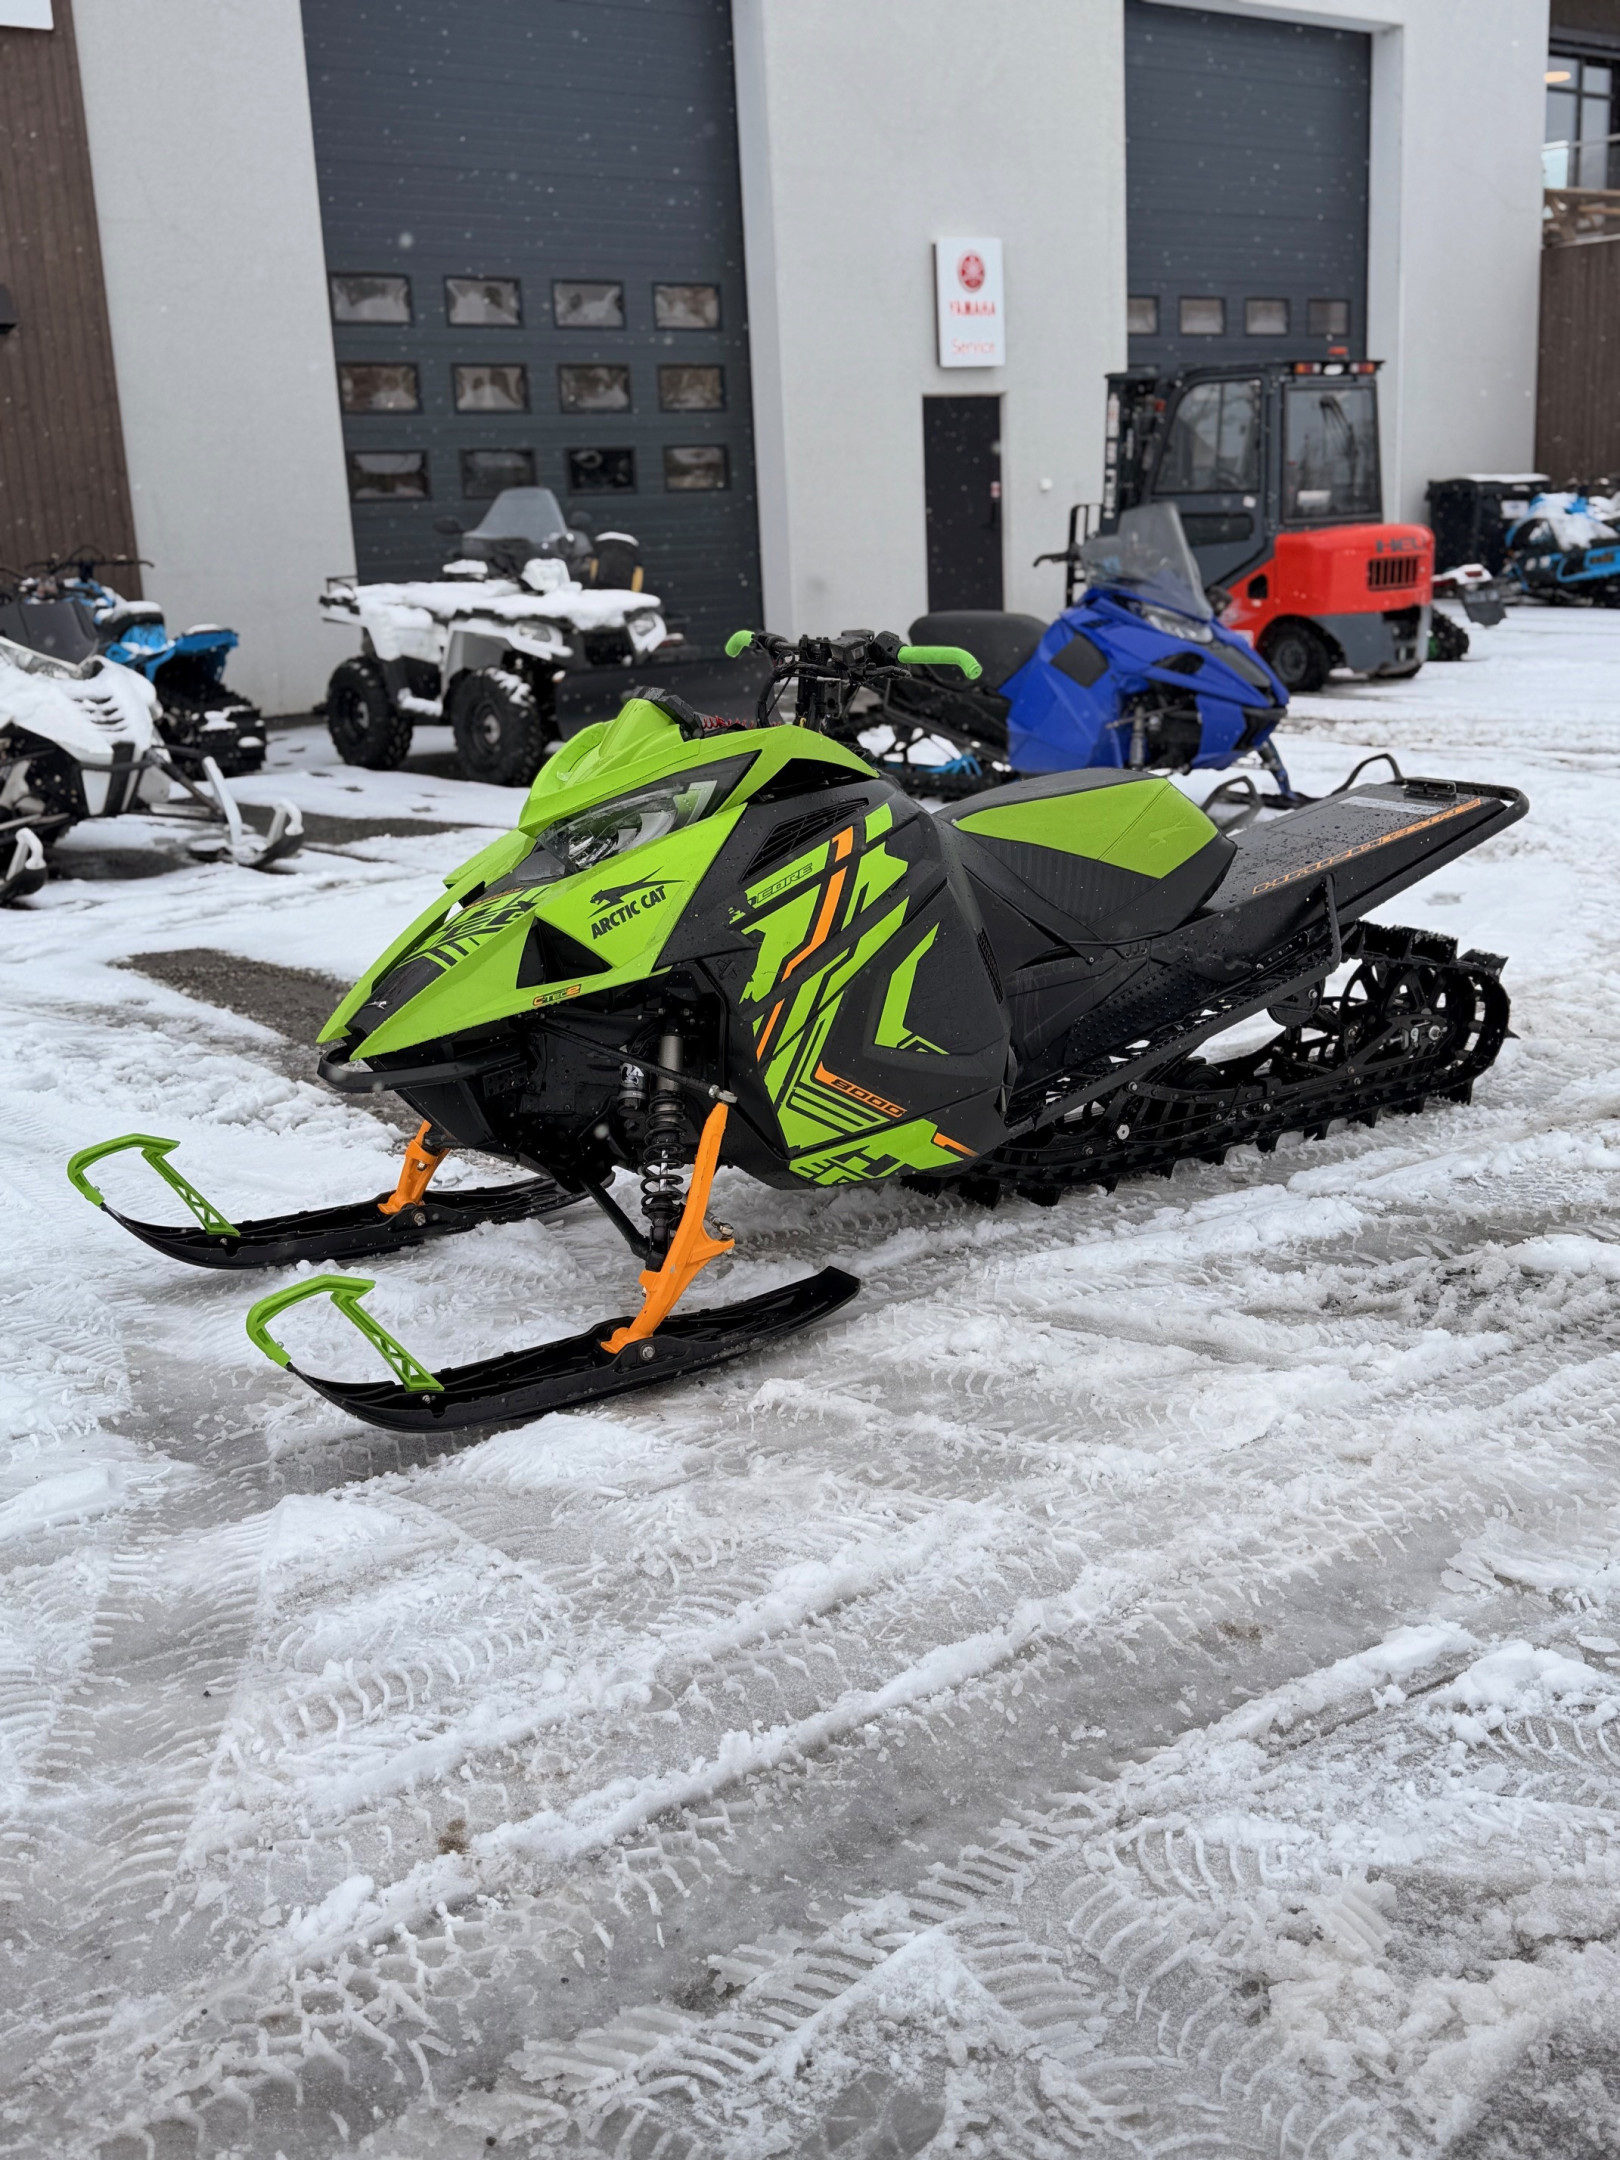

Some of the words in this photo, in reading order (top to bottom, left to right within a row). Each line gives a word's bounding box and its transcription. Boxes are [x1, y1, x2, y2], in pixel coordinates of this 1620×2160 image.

[952, 339, 996, 354] Service
[591, 900, 641, 940] ARCTIC
[640, 885, 667, 909] CAT
[831, 1078, 905, 1116] 8000
